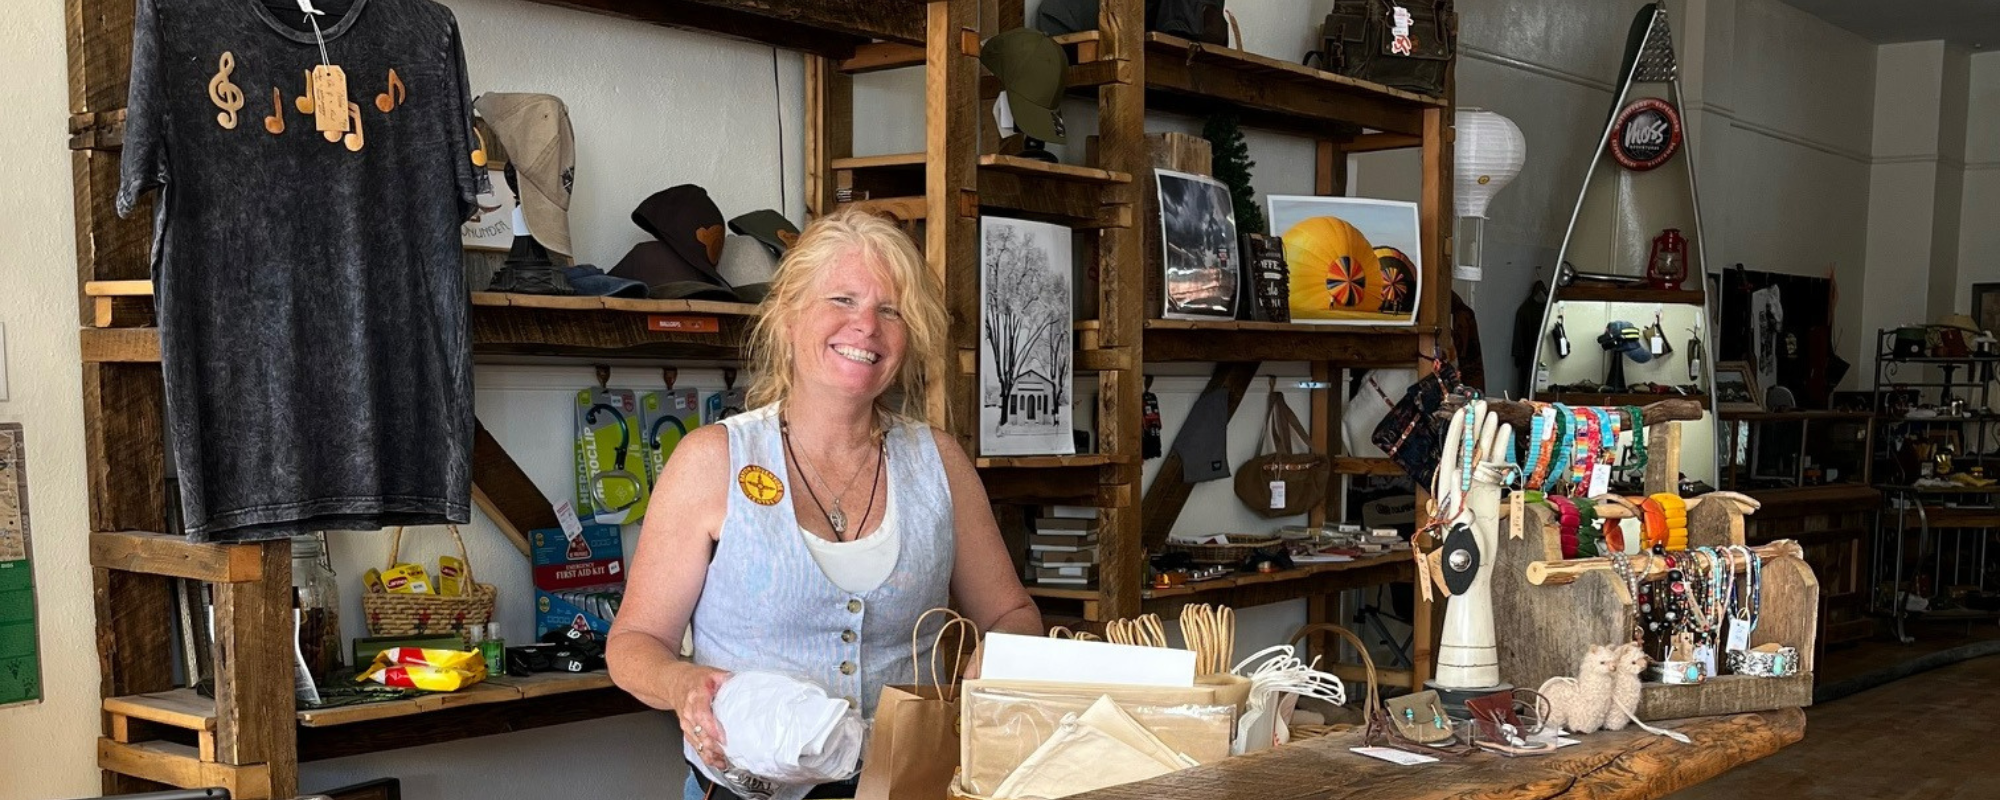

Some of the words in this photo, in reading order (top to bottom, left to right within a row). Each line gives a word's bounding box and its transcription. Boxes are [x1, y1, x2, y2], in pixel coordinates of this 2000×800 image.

[556, 570, 577, 580] FIRST
[577, 567, 592, 578] AID
[592, 566, 605, 575] KIT
